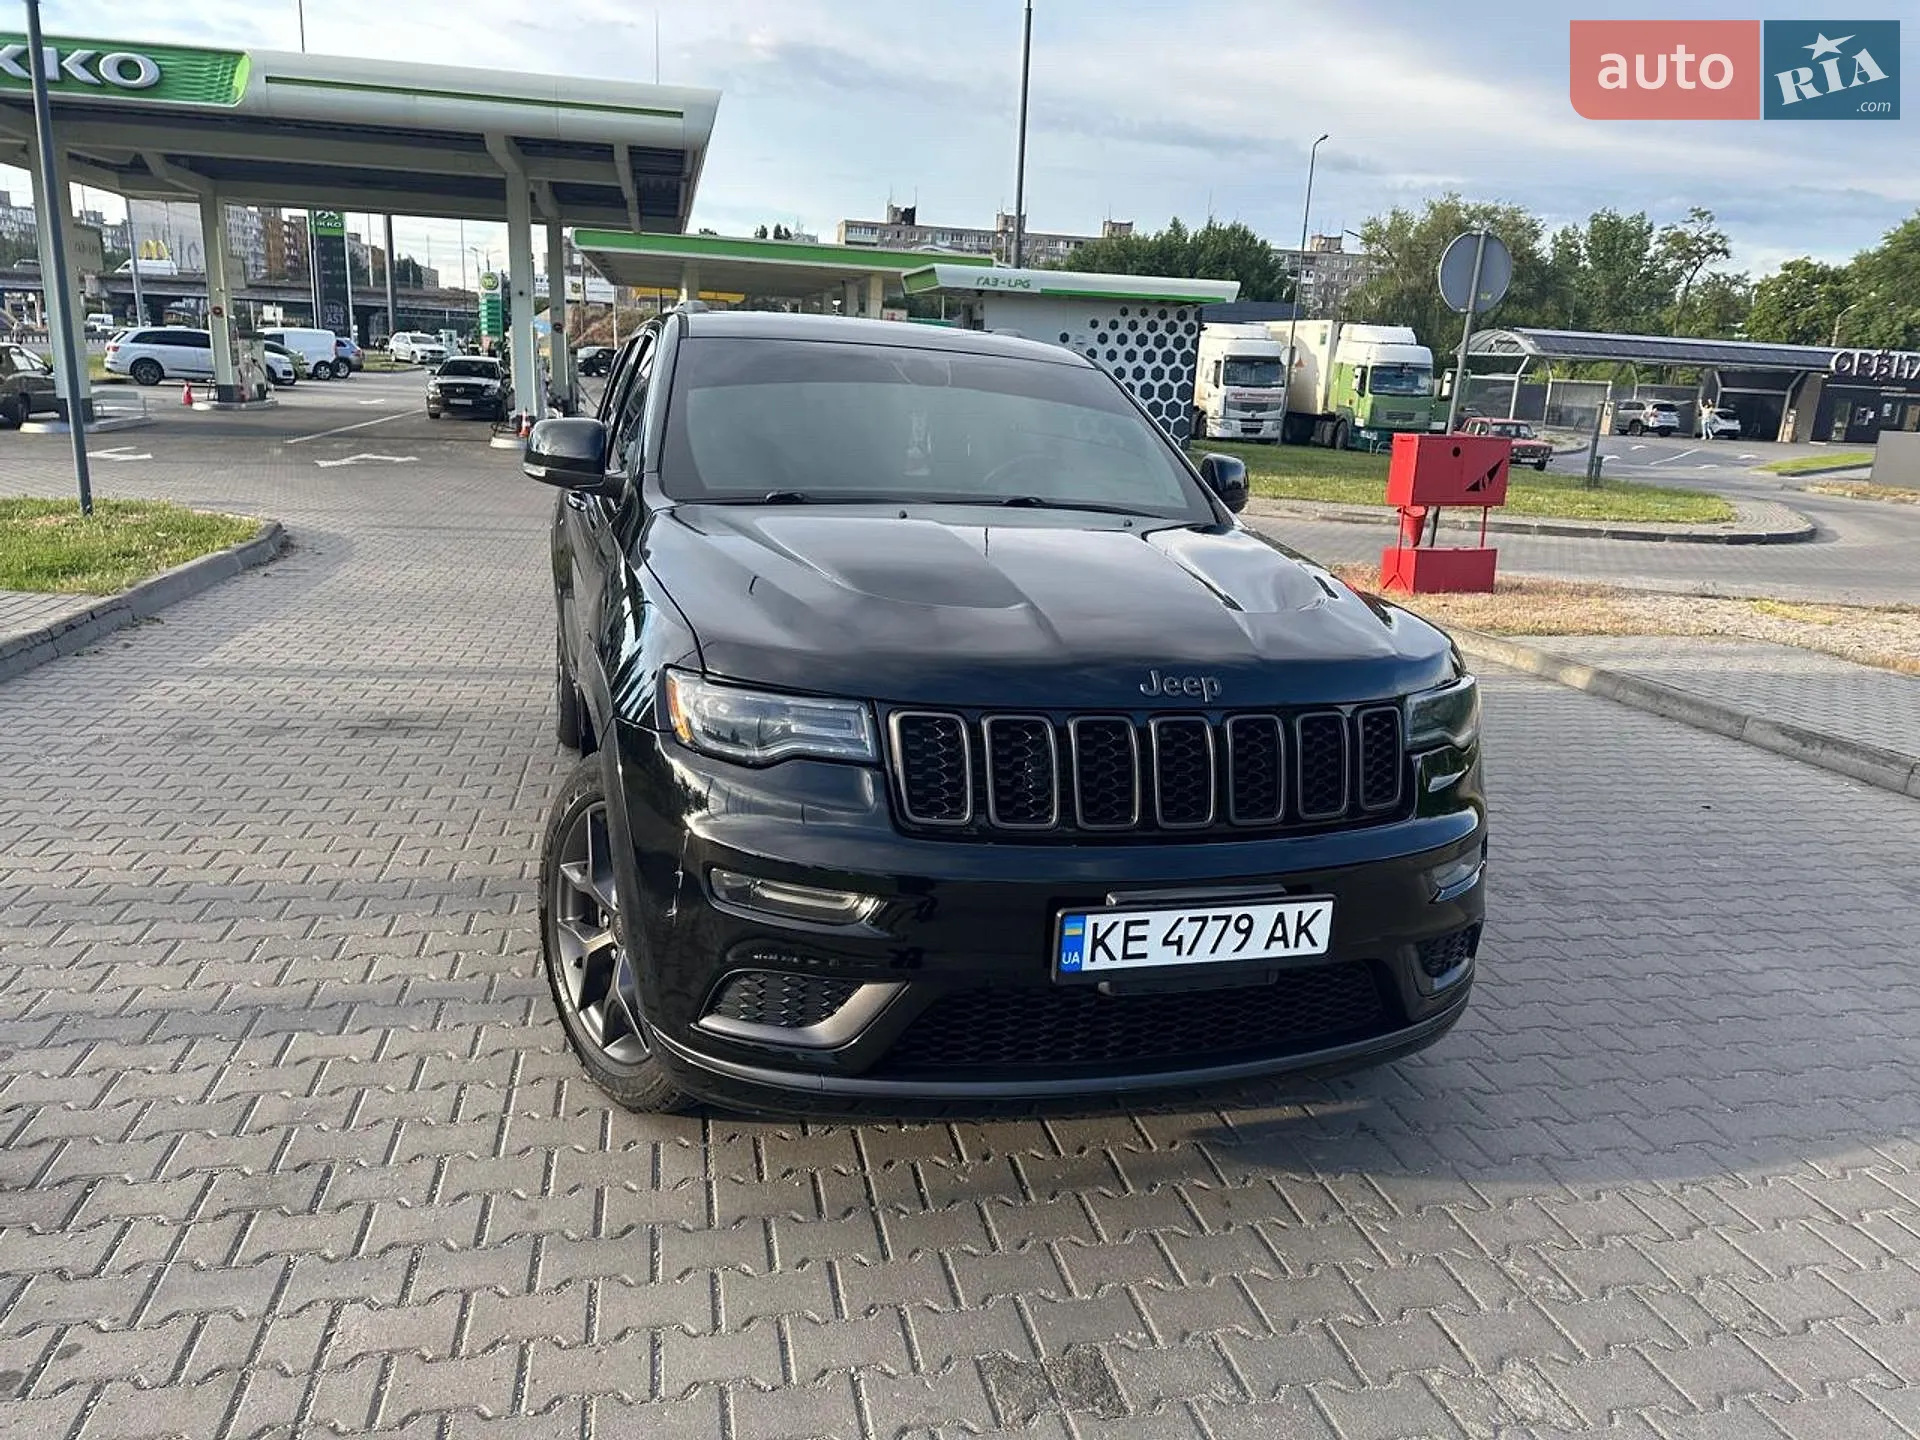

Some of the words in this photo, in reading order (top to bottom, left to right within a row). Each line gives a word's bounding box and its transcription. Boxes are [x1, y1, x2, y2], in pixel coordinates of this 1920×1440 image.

[1139, 669, 1223, 702] Jeep
[1089, 919, 1150, 963] KE
[1161, 913, 1254, 957] 4779
[1264, 908, 1323, 951] AK
[1062, 951, 1080, 965] UA
